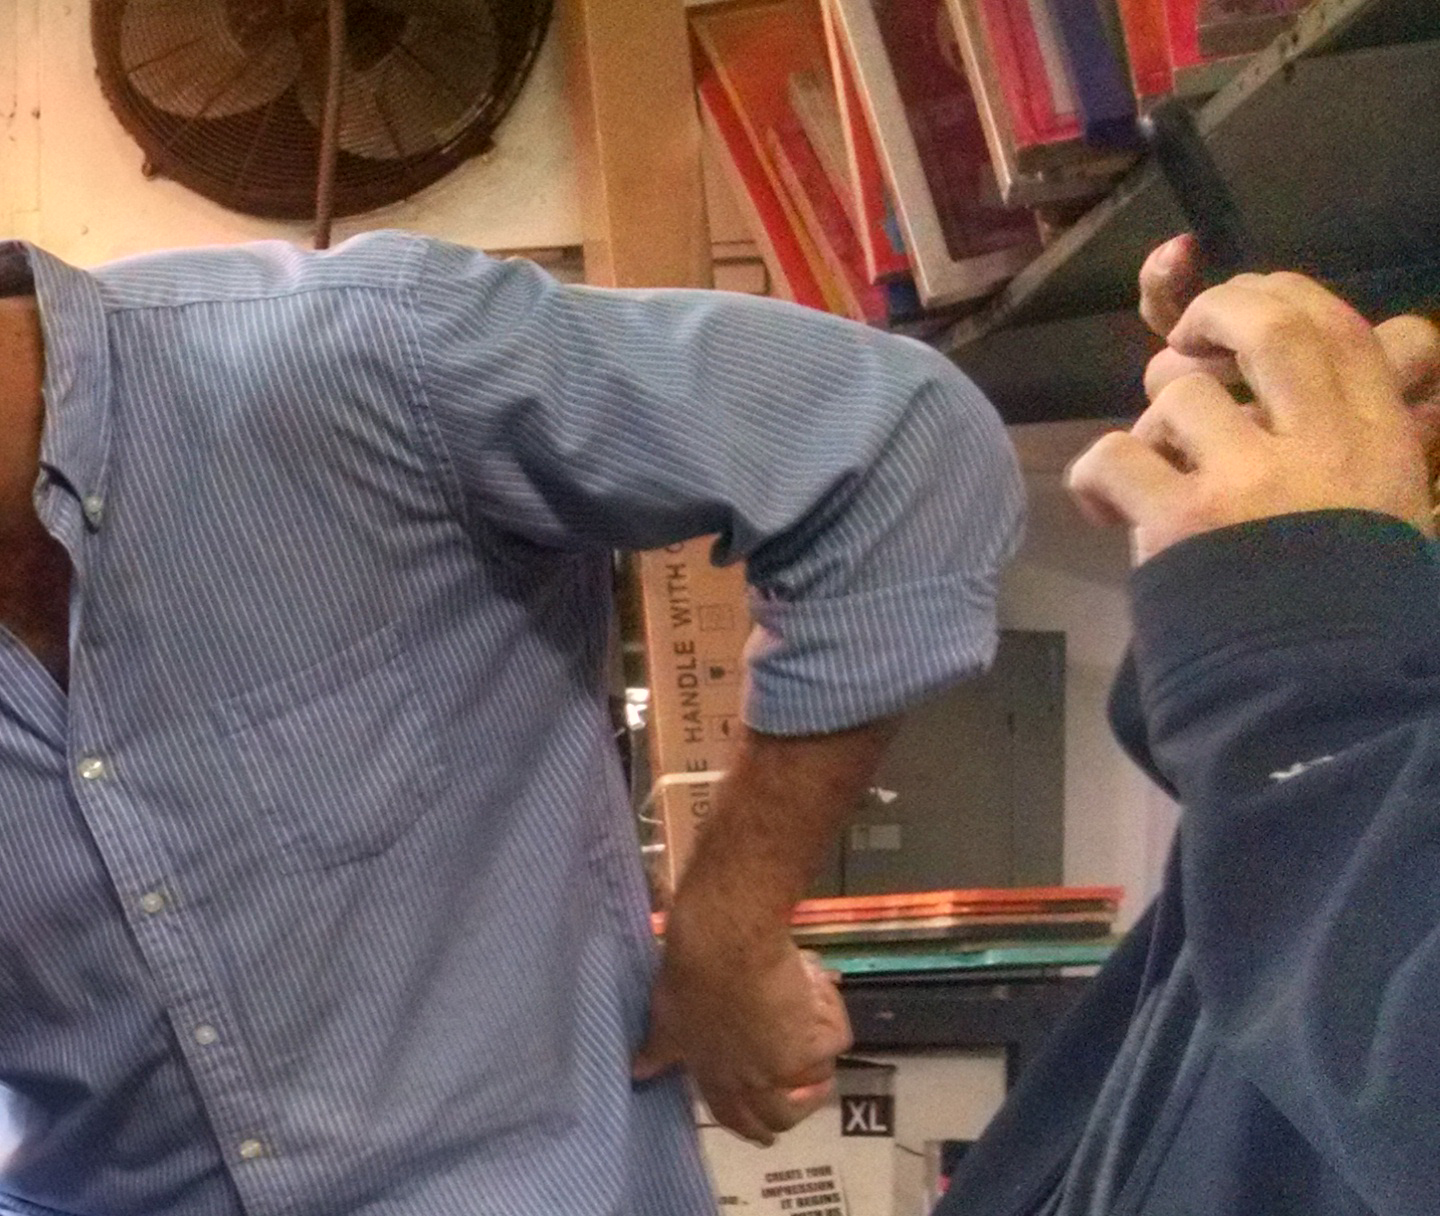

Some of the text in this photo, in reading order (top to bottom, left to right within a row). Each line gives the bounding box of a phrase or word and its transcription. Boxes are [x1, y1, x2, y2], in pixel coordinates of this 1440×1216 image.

[665, 562, 693, 630] WITH
[674, 640, 706, 744] HANDLE
[846, 1101, 888, 1132] XL
